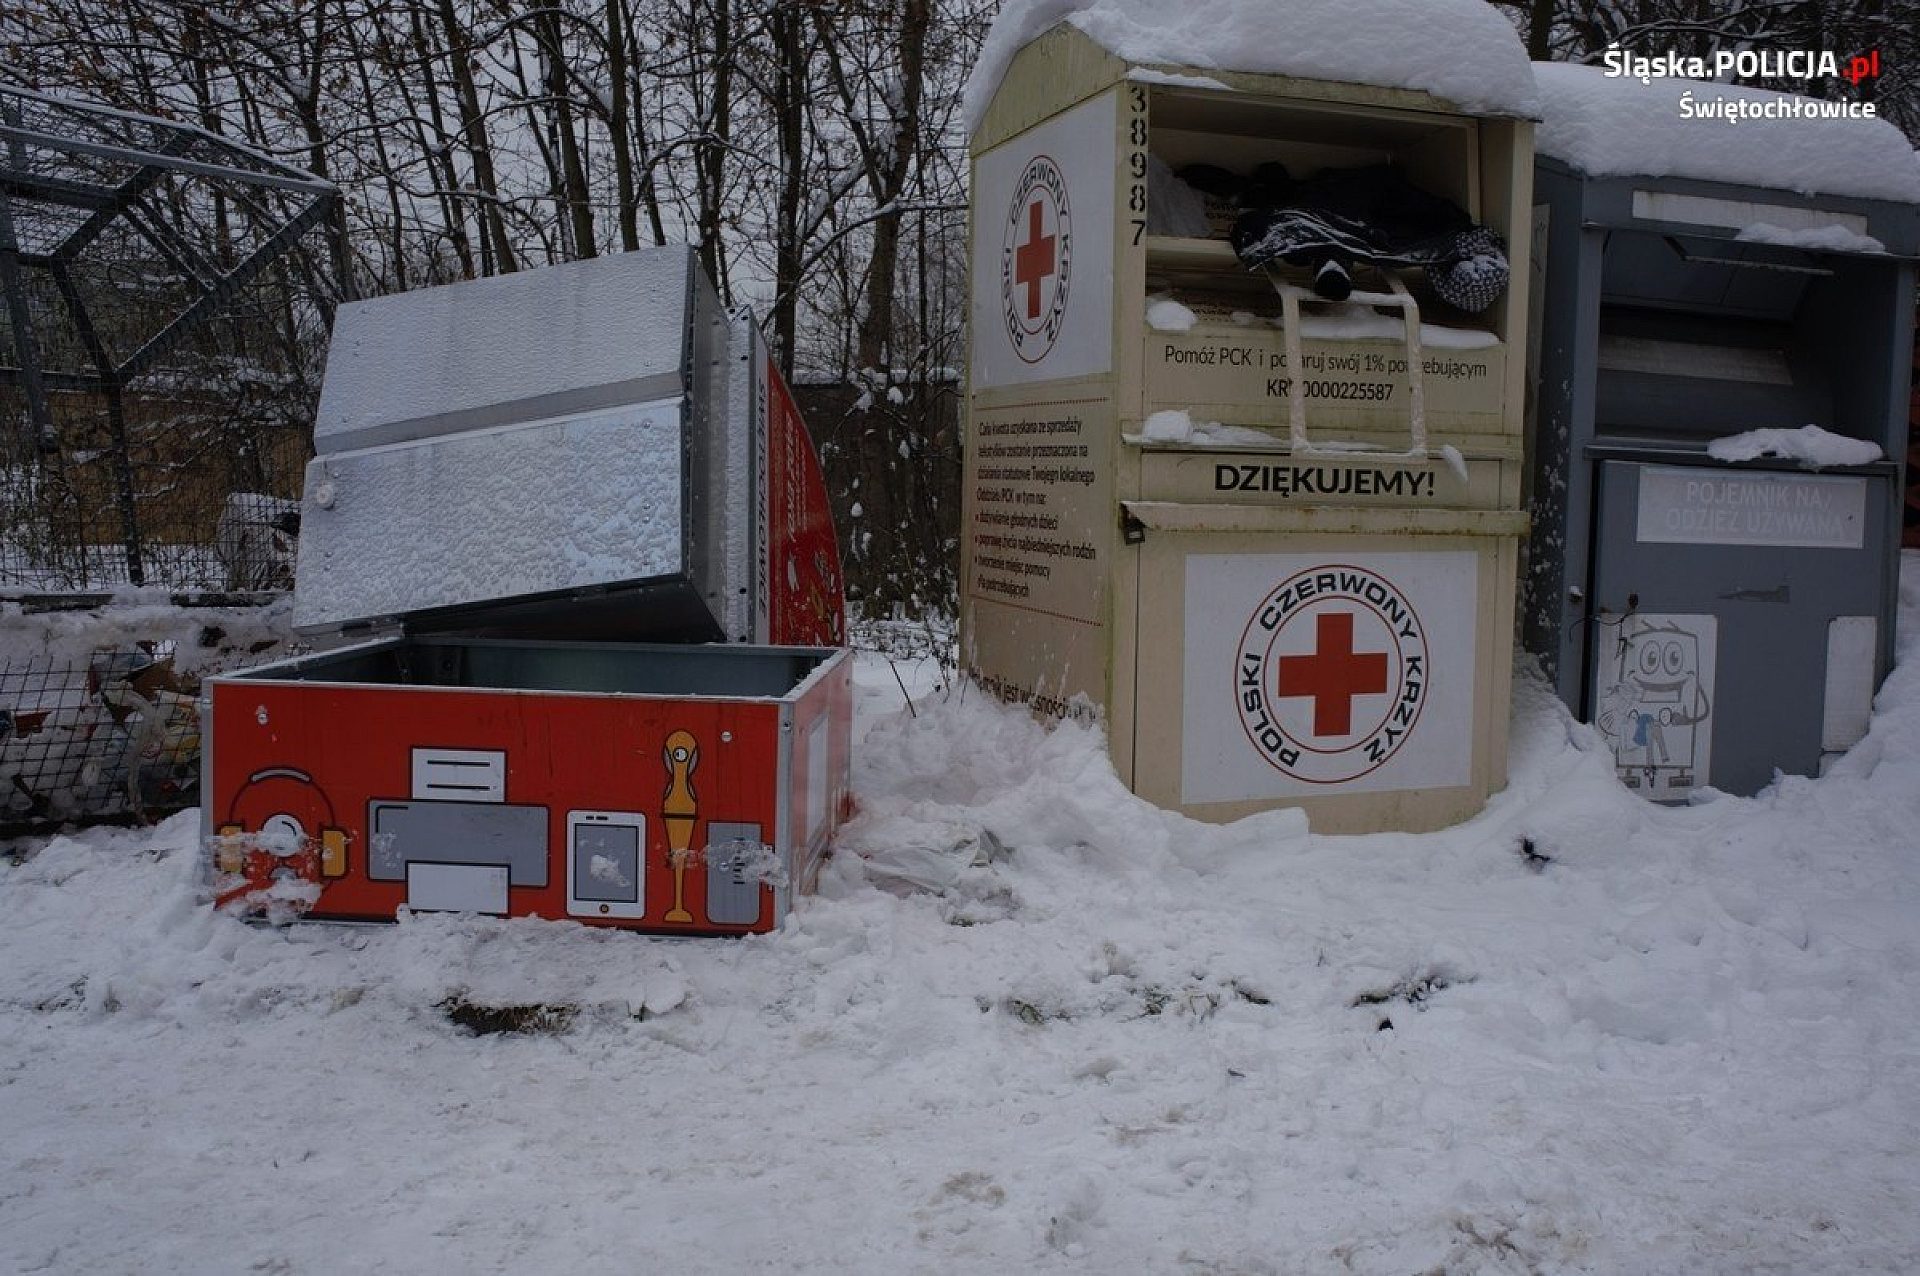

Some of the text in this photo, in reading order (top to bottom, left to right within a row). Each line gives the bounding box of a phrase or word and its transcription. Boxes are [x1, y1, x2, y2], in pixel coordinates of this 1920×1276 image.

[1130, 87, 1146, 246] 38987
[1165, 345, 1487, 380] Pomóż PCK i poruj swój 1% poebującym
[1215, 464, 1435, 499] DZIĘKUJEMY!
[1686, 481, 1790, 507] POJEMNIK
[1242, 572, 1423, 768] POLSKI CZERWONY KRZYŻ
